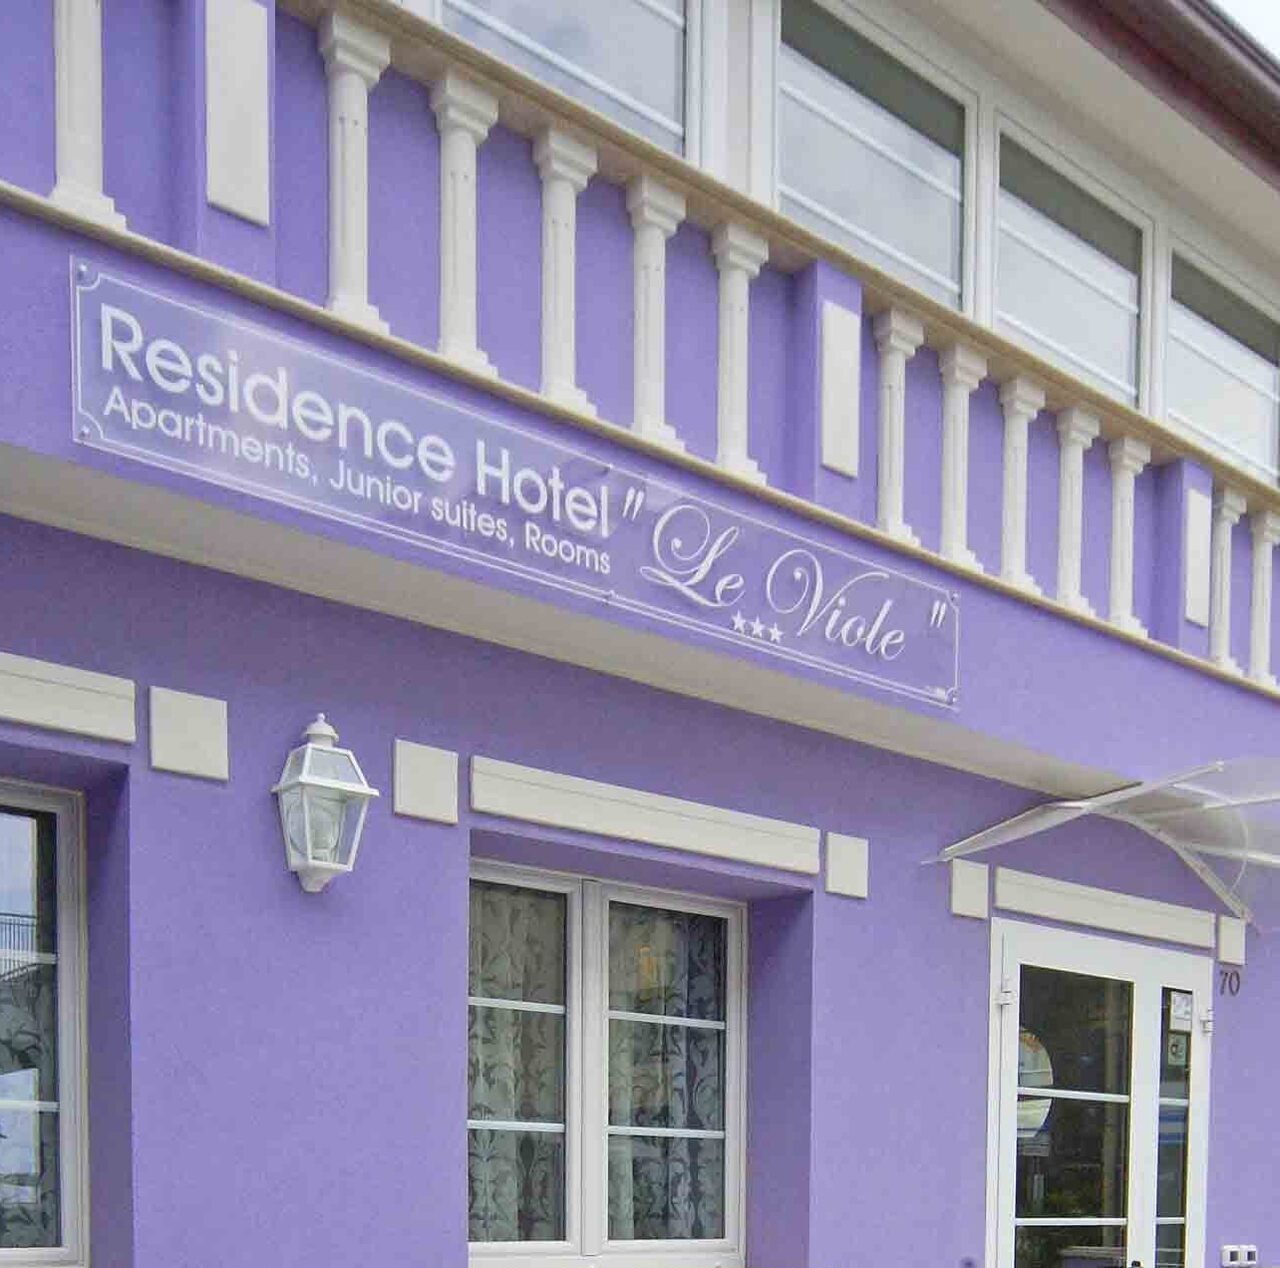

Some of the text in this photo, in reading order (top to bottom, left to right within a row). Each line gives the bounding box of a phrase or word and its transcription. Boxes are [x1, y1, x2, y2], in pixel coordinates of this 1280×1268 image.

[101, 302, 456, 483] Residence
[476, 439, 610, 538] Hotel
[103, 386, 612, 574] Apartments, Junior suites, Rooms
[1219, 970, 1241, 997] 70
